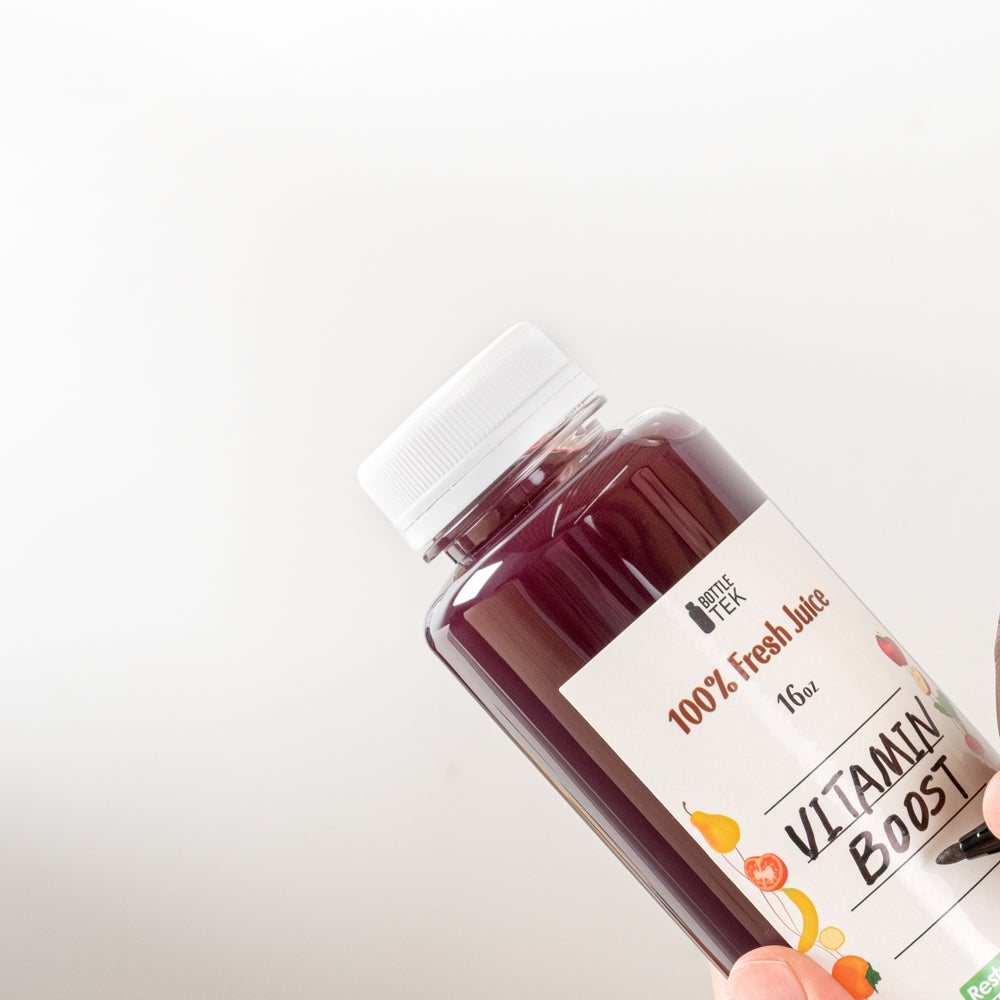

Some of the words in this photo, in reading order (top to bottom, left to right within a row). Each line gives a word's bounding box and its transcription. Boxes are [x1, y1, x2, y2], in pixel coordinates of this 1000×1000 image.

[698, 574, 734, 609] BOTTLE
[708, 587, 747, 621] TEK
[668, 668, 738, 735] 100%
[727, 620, 793, 681] Fresh
[782, 588, 830, 634] Juice
[777, 680, 820, 714] 16oz
[784, 695, 940, 861] VITAMIN
[848, 755, 969, 886] BOOST
